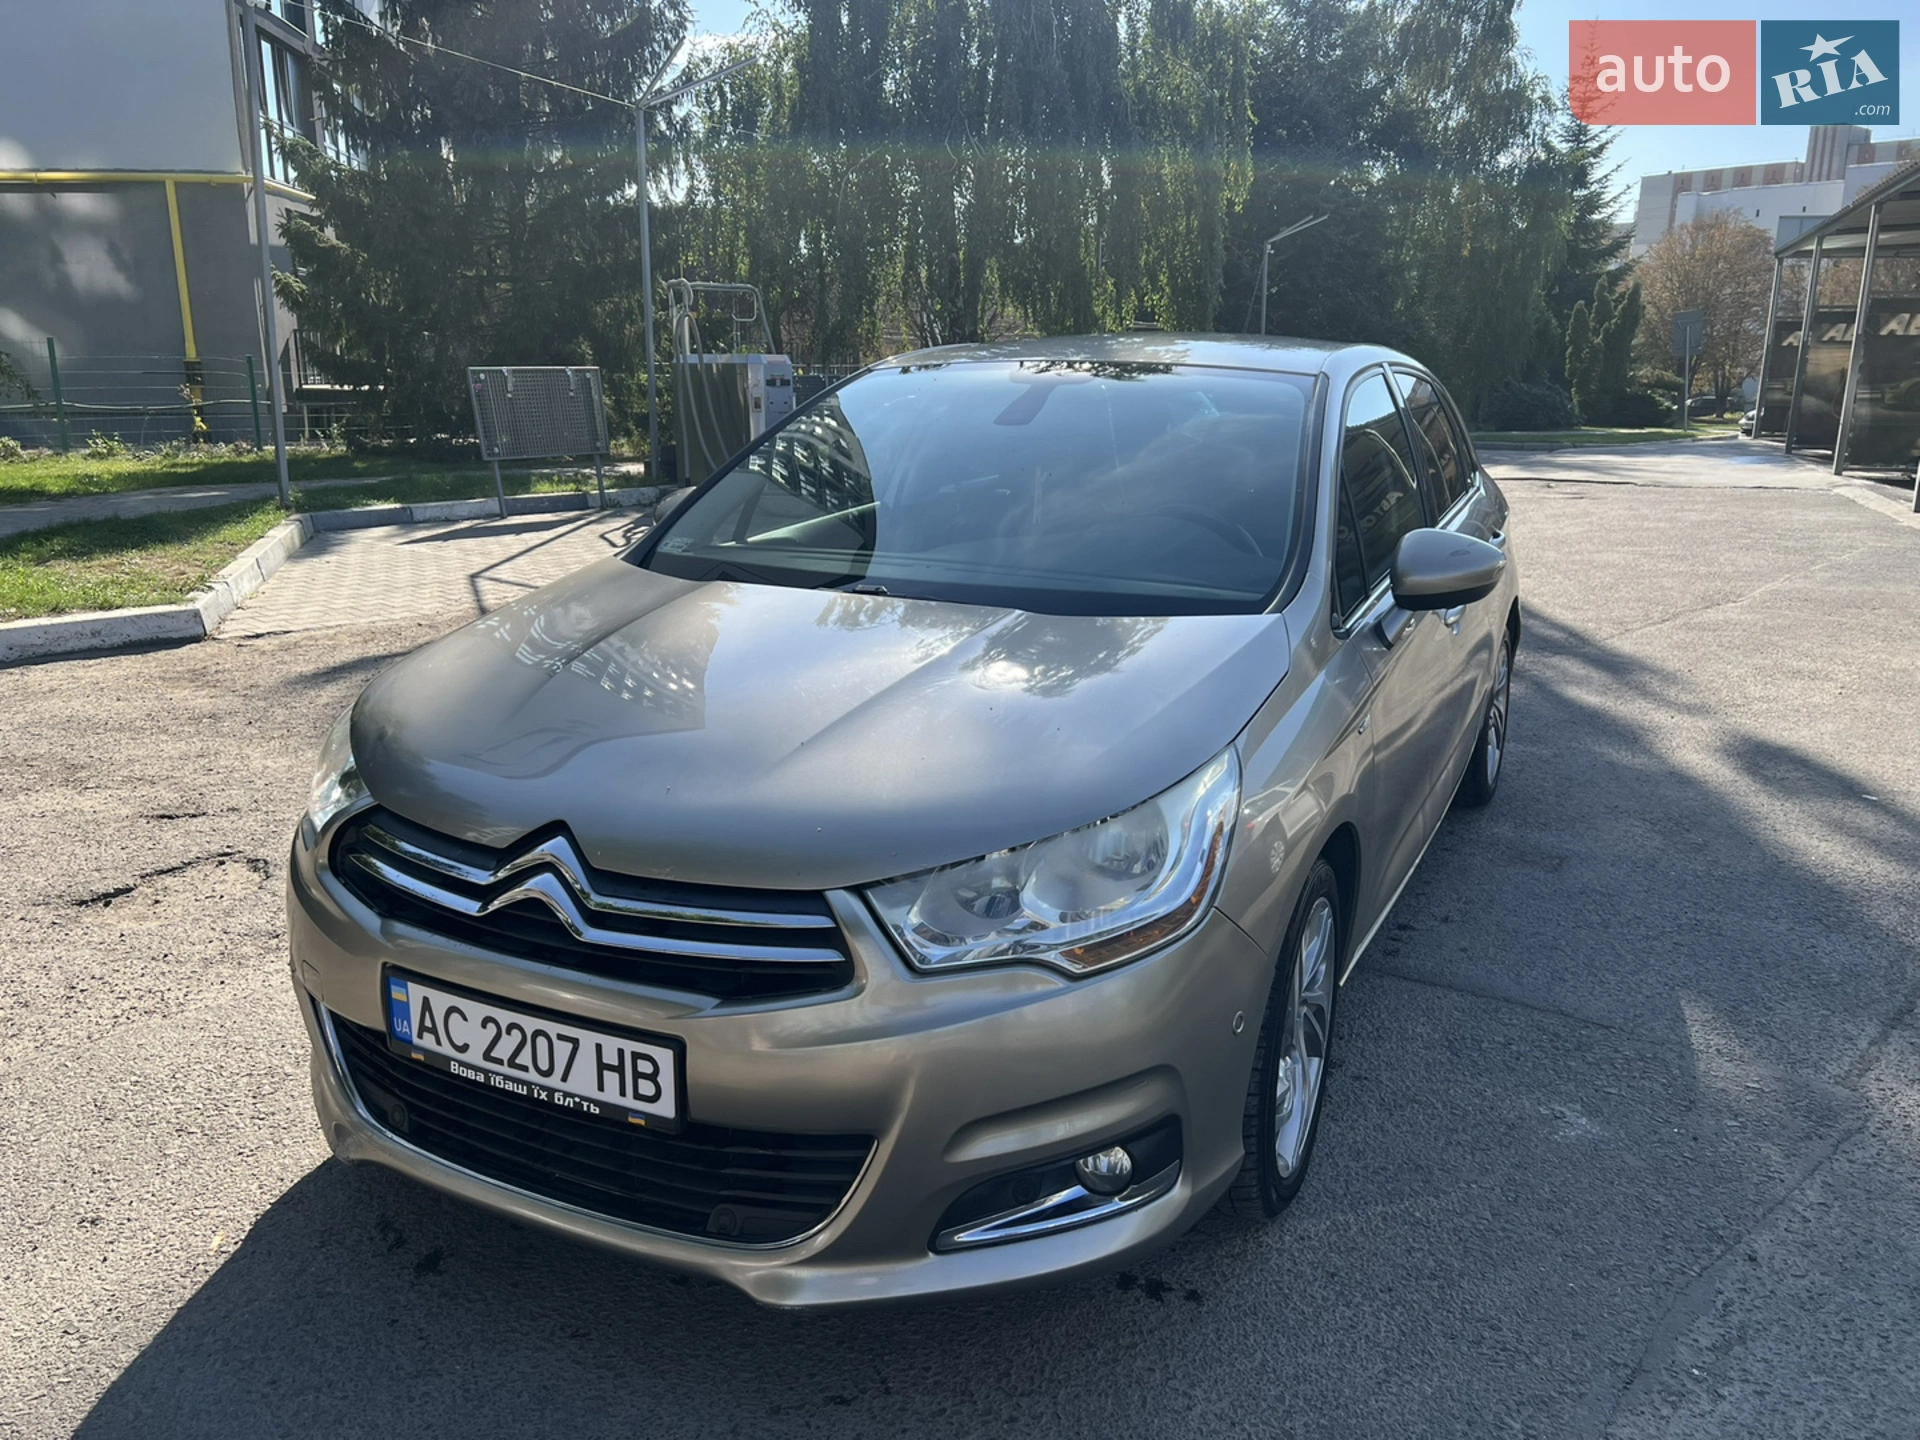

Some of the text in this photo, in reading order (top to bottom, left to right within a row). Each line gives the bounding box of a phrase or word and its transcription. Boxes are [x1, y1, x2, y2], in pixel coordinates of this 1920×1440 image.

[393, 1016, 412, 1036] UA
[416, 995, 663, 1105] AC 2207 HB
[450, 1060, 485, 1083] Вова
[532, 1085, 548, 1101] їх
